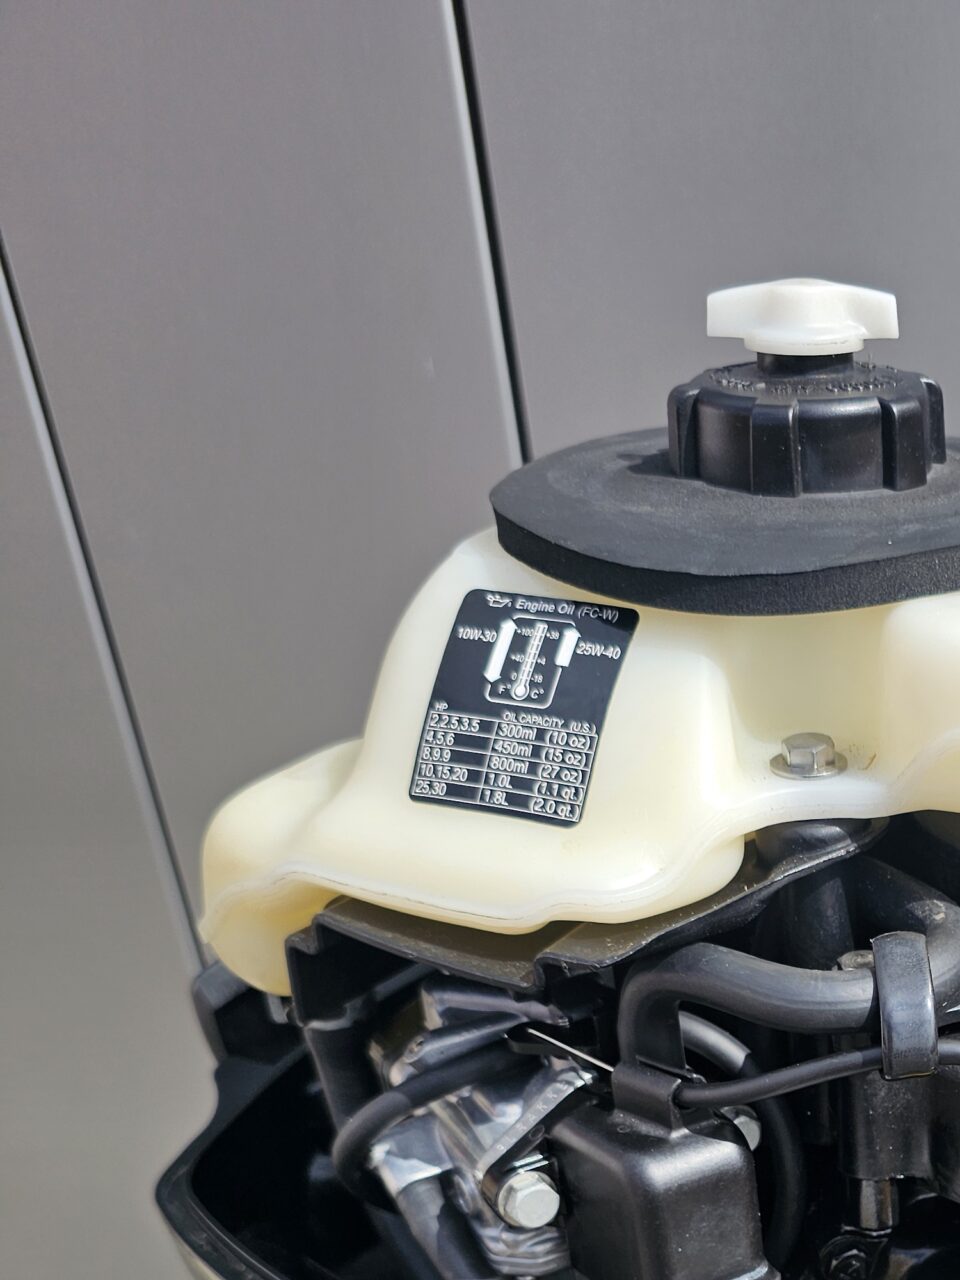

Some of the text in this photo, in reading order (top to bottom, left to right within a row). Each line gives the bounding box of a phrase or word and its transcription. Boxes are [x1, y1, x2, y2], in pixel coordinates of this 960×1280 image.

[516, 600, 619, 623] Engine Oil (FC-W)
[457, 627, 498, 643] 10W-30
[576, 642, 621, 660] 25W-40
[434, 702, 448, 711] HP
[503, 712, 518, 723] OIL
[519, 714, 565, 728] CAPACITY
[498, 723, 590, 749] 300ml (10 oz)
[494, 740, 586, 766] 450ml (15 oz)
[490, 757, 582, 783] 800ml (27 oz)
[415, 781, 447, 797] 25,30
[488, 773, 584, 803] 1.0L (1.1 qt.)
[484, 790, 580, 821] 1.8L (2.0 qt.)
